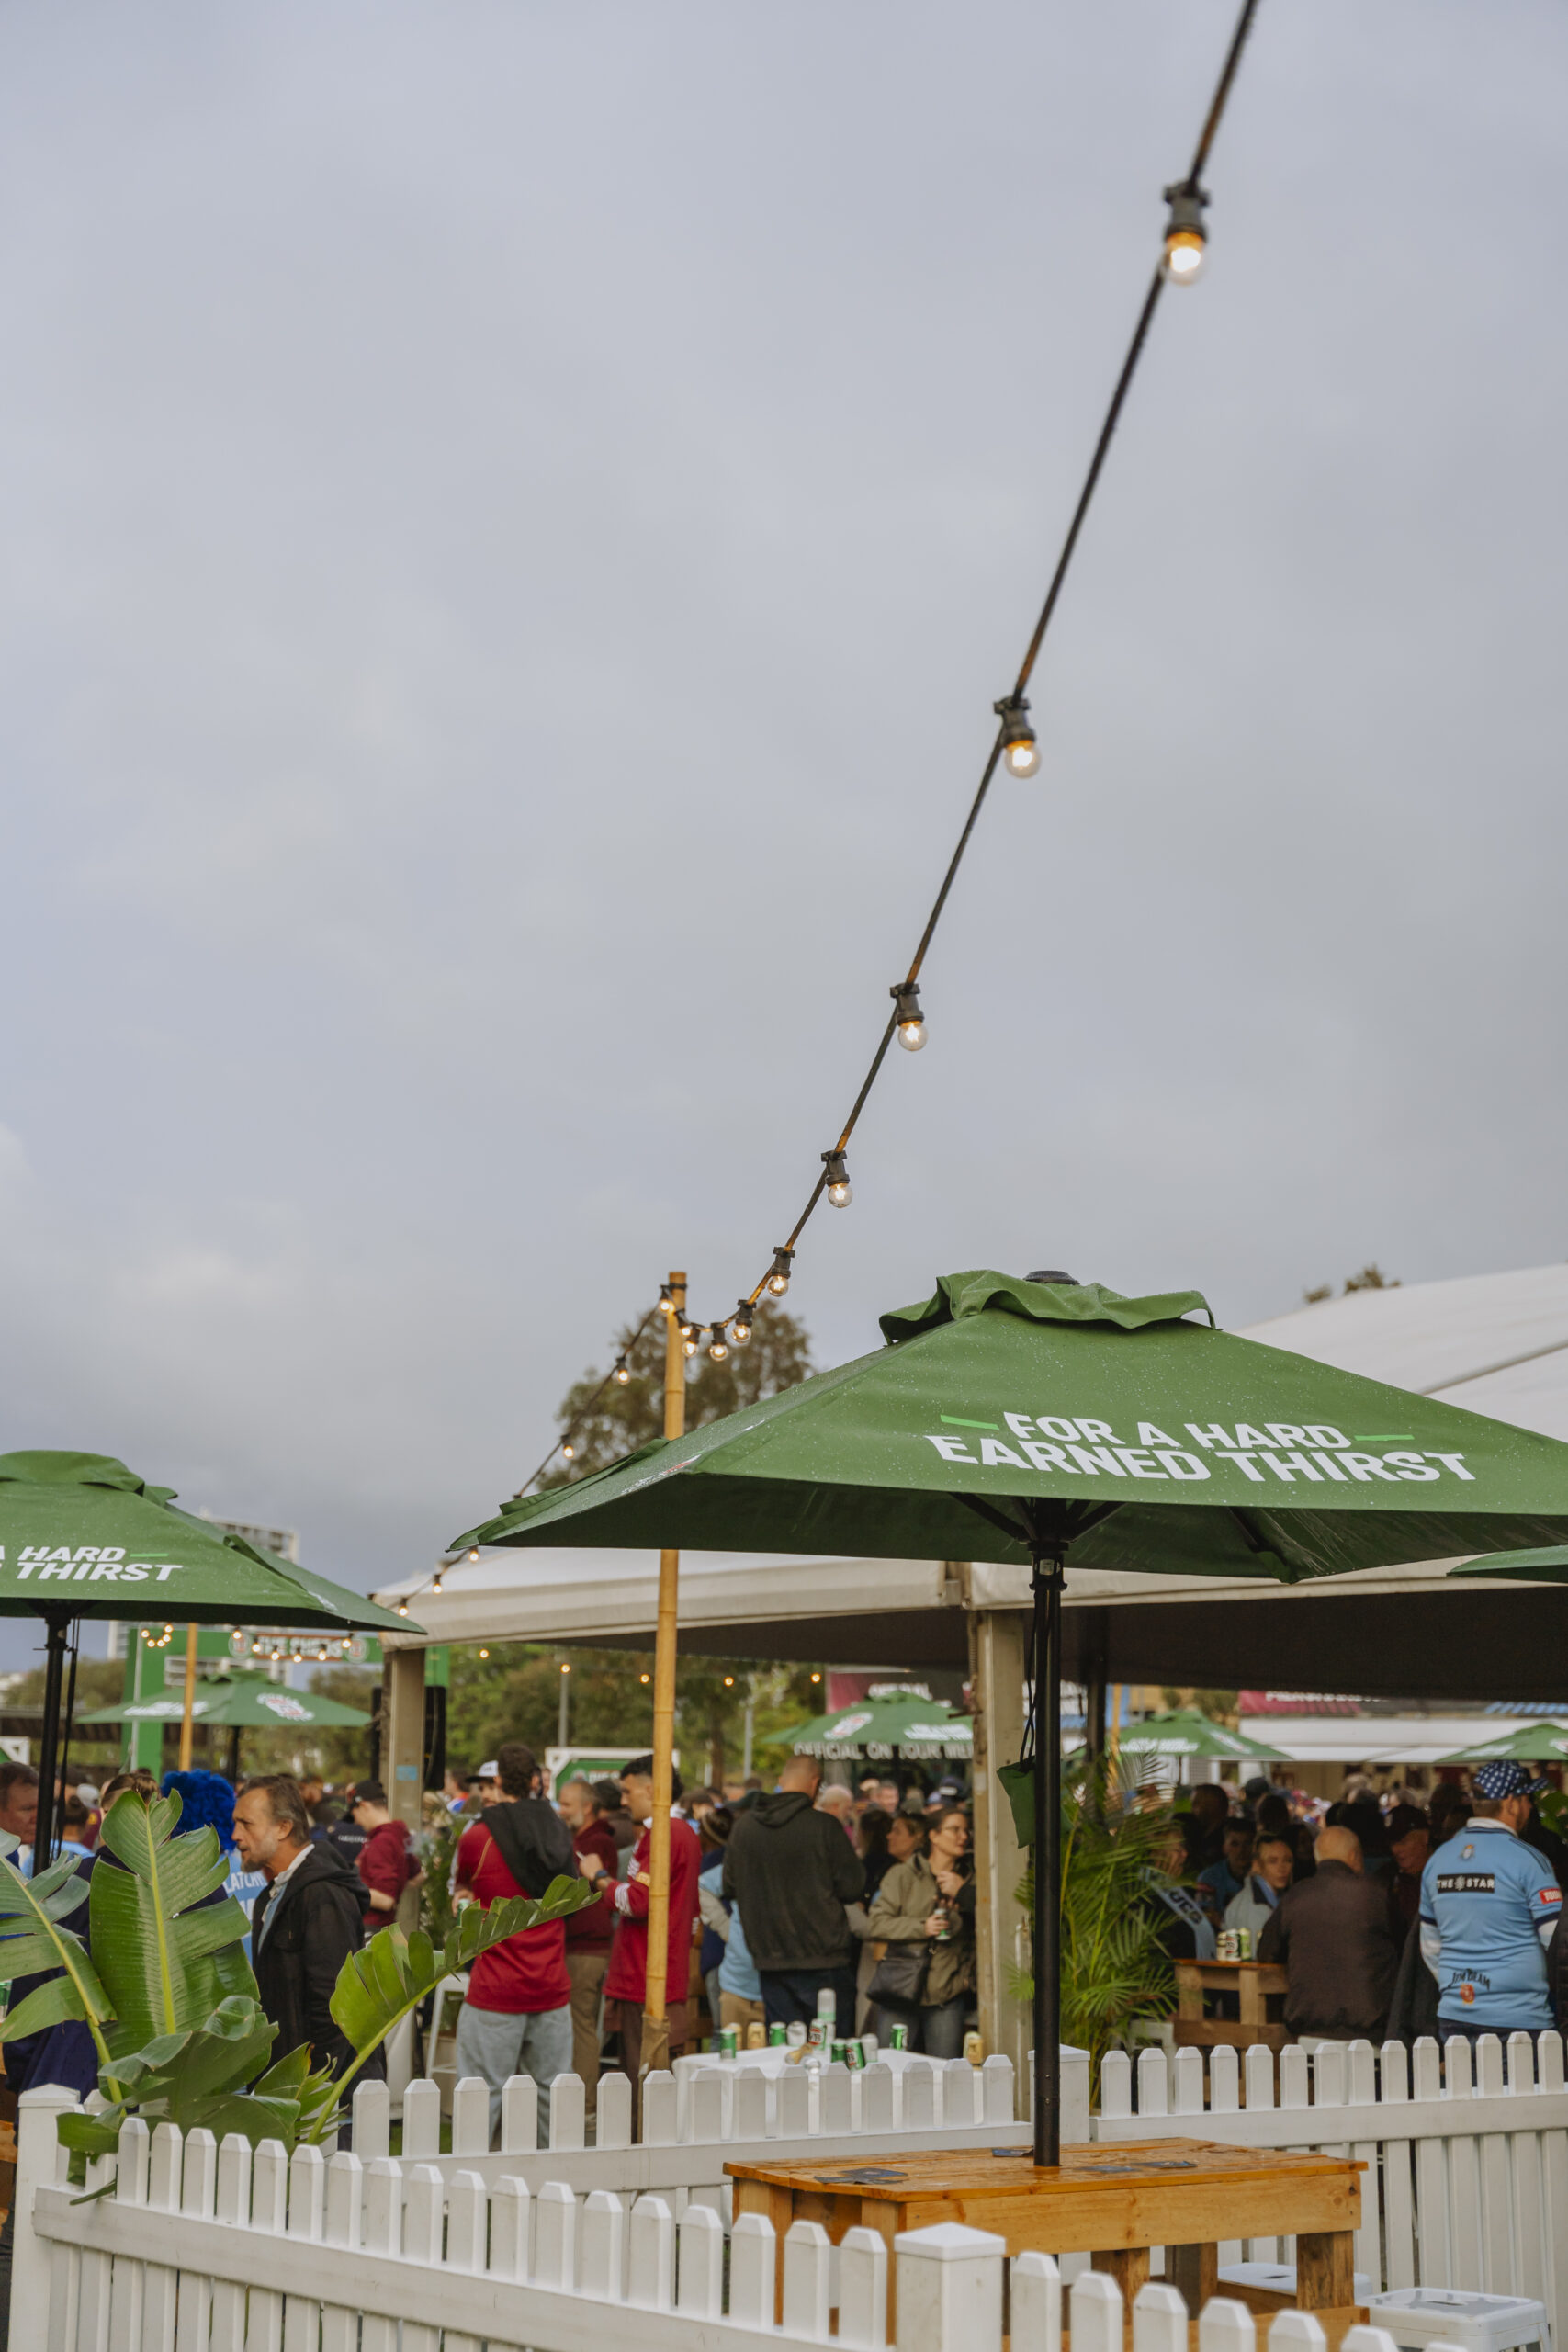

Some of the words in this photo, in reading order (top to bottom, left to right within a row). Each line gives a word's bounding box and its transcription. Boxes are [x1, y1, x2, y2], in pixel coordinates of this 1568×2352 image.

[1003, 1411, 1126, 1444] FOR
[1137, 1422, 1183, 1448] A
[1183, 1423, 1351, 1449] HARD
[923, 1435, 1212, 1480] EARNED
[1214, 1452, 1476, 1481] THIRST
[17, 1546, 127, 1562] HARD
[17, 1562, 184, 1581] THIRST
[867, 1741, 894, 1760] ON
[1438, 1880, 1454, 1889] THE
[1466, 1878, 1495, 1889] STAR
